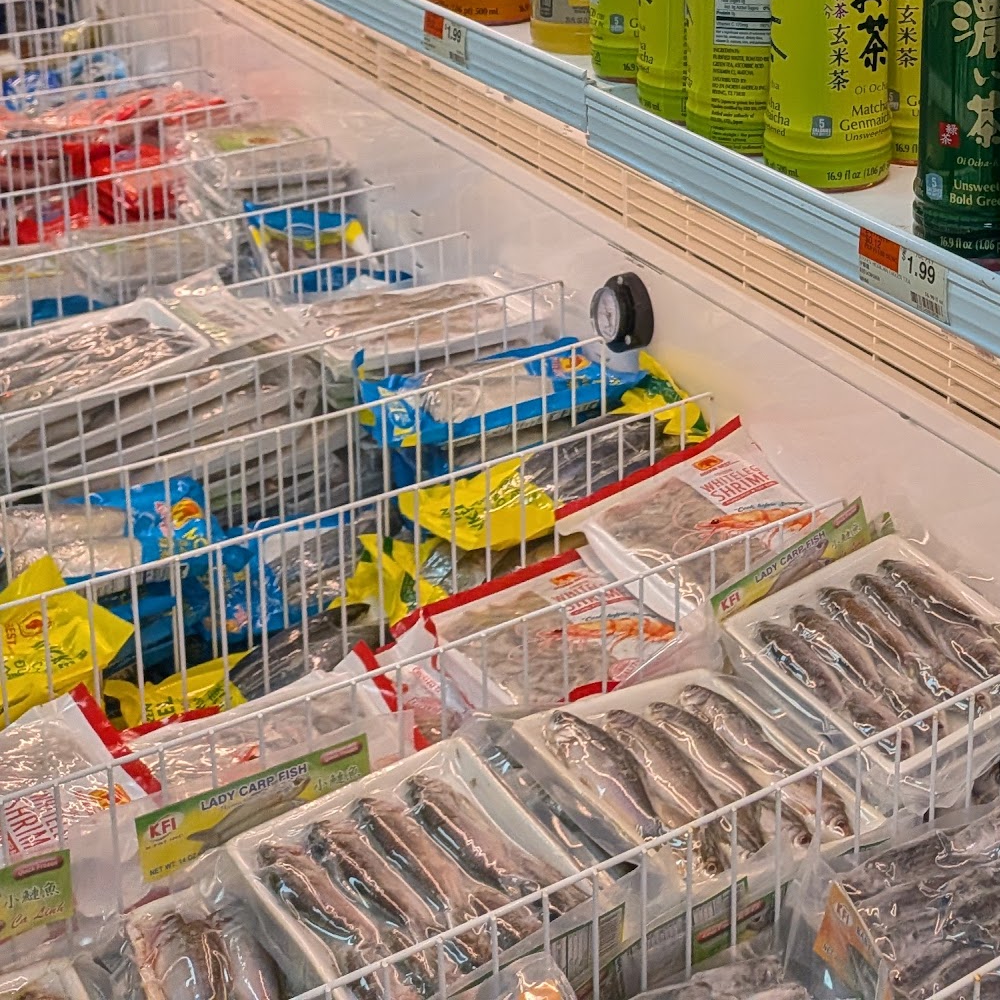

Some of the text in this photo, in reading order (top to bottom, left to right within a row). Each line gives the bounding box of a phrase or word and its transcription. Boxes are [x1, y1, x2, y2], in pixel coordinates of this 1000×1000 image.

[895, 4, 920, 69] 玄米茶
[828, 22, 851, 92] 玄米茶
[854, 84, 866, 95] Oi
[826, 171, 842, 181] 16.9
[950, 192, 973, 206] Bold
[939, 236, 954, 249] 16.9
[700, 464, 762, 493] WHITELEG
[755, 530, 826, 583] LADY CARP FISH
[719, 590, 741, 612] KFI
[201, 763, 308, 811] LADY CARP FISH
[149, 817, 178, 839] KFI
[150, 864, 163, 876] NET
